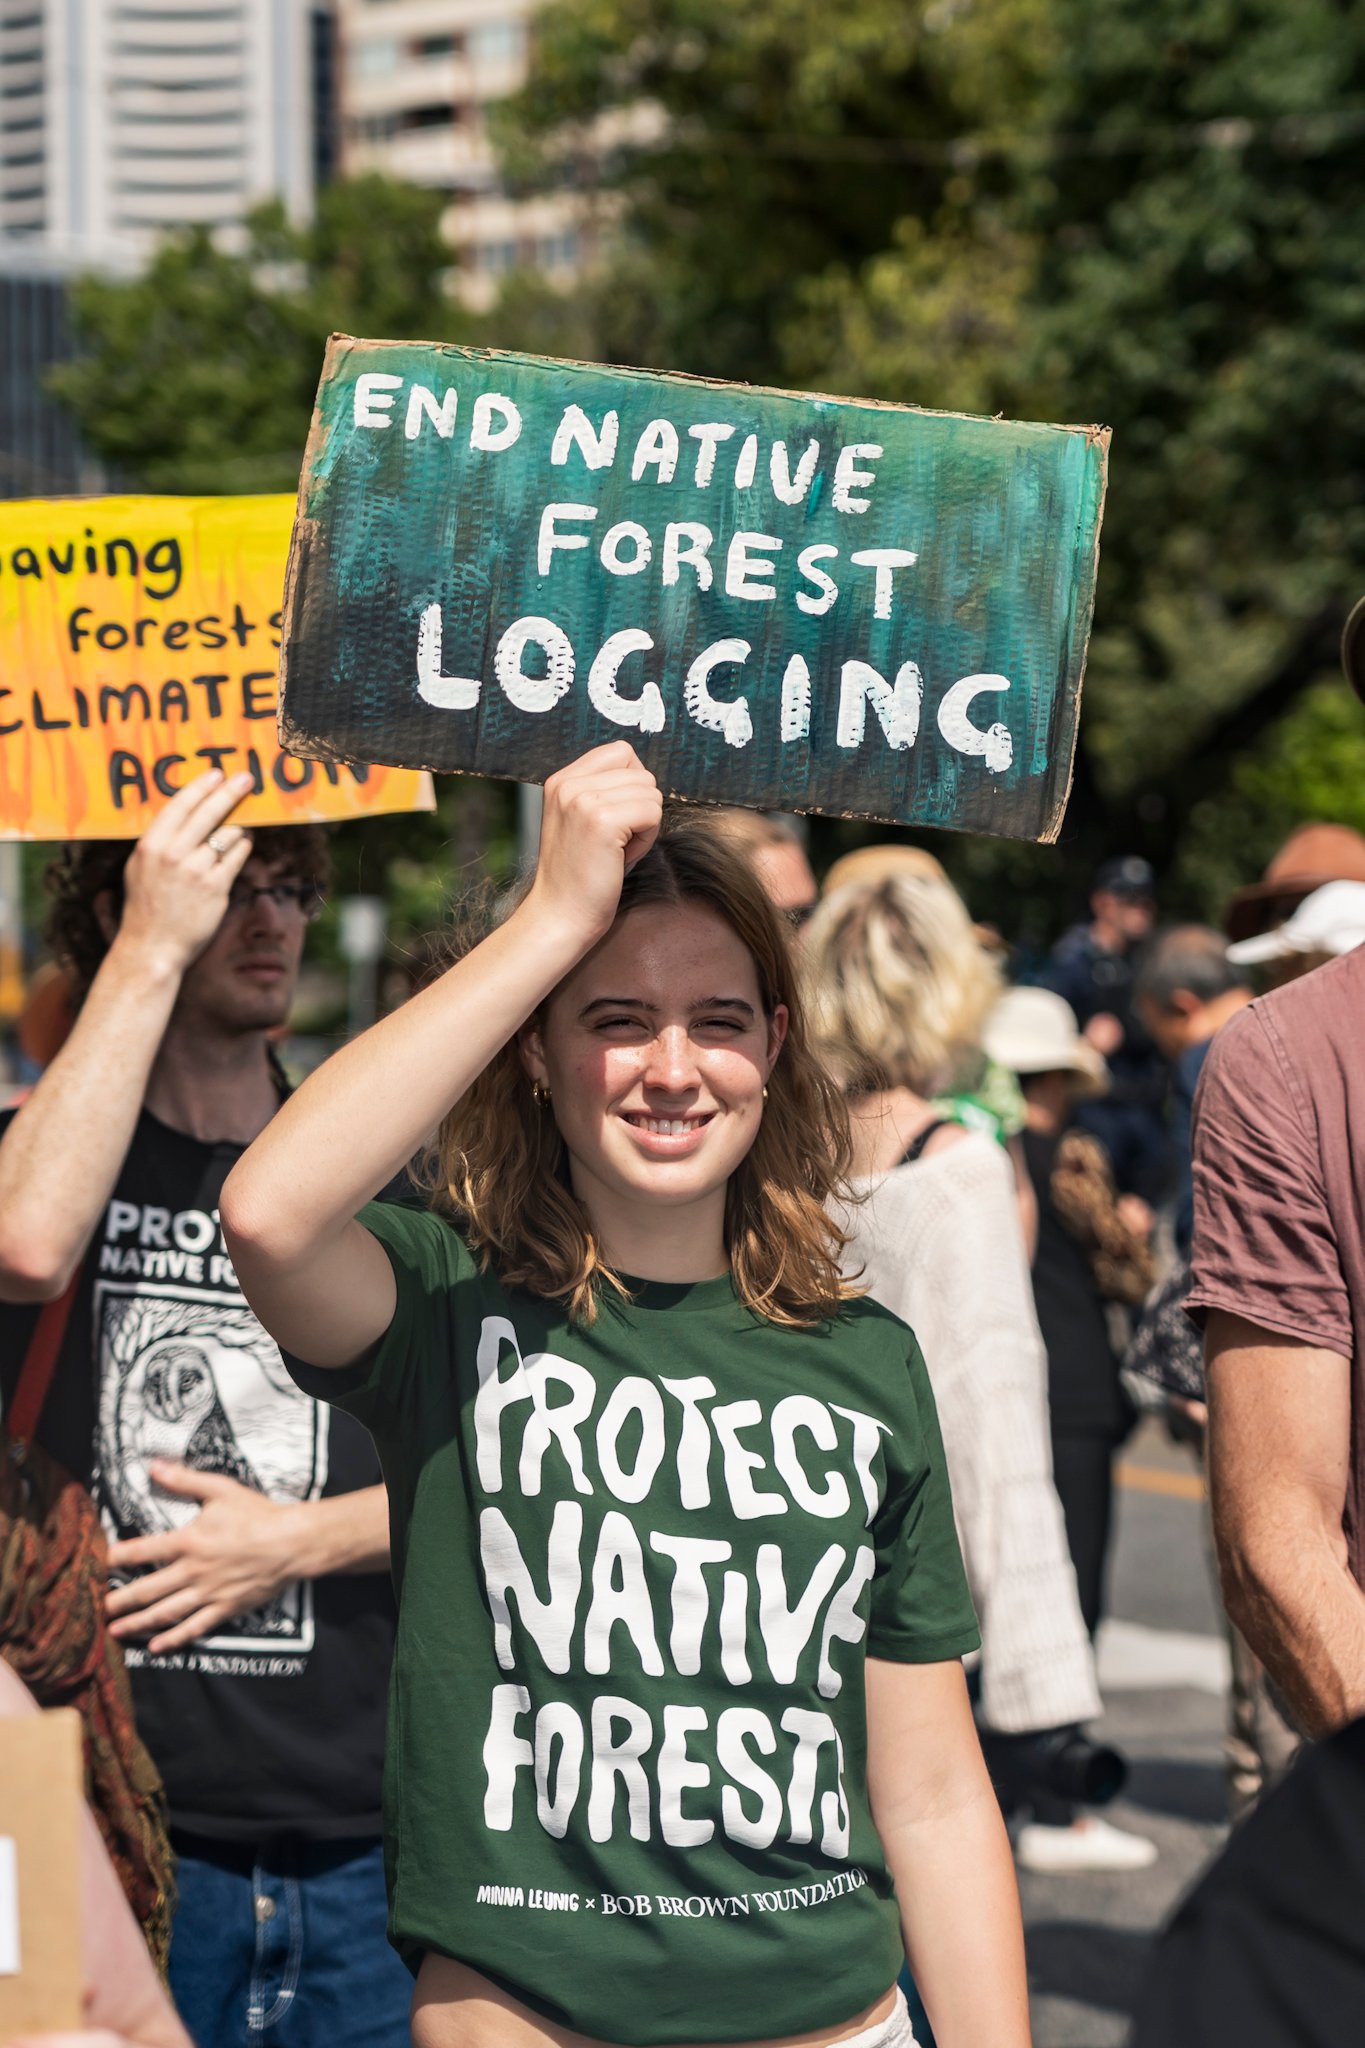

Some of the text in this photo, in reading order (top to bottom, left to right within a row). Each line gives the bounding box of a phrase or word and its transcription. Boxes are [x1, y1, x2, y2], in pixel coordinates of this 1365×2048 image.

[353, 373, 884, 514] END NATIVE
[0, 528, 183, 600] aving
[537, 503, 919, 620] FOREST
[417, 601, 1014, 774] LOGGING
[100, 1244, 204, 1283] NATIVE
[474, 1316, 894, 1527] PROTECT
[480, 1501, 875, 1698] NATIVE
[476, 1886, 525, 1908] MINNA
[528, 1888, 580, 1912] LEUNIG
[601, 1893, 653, 1917] BOB
[655, 1894, 750, 1918] BROWN
